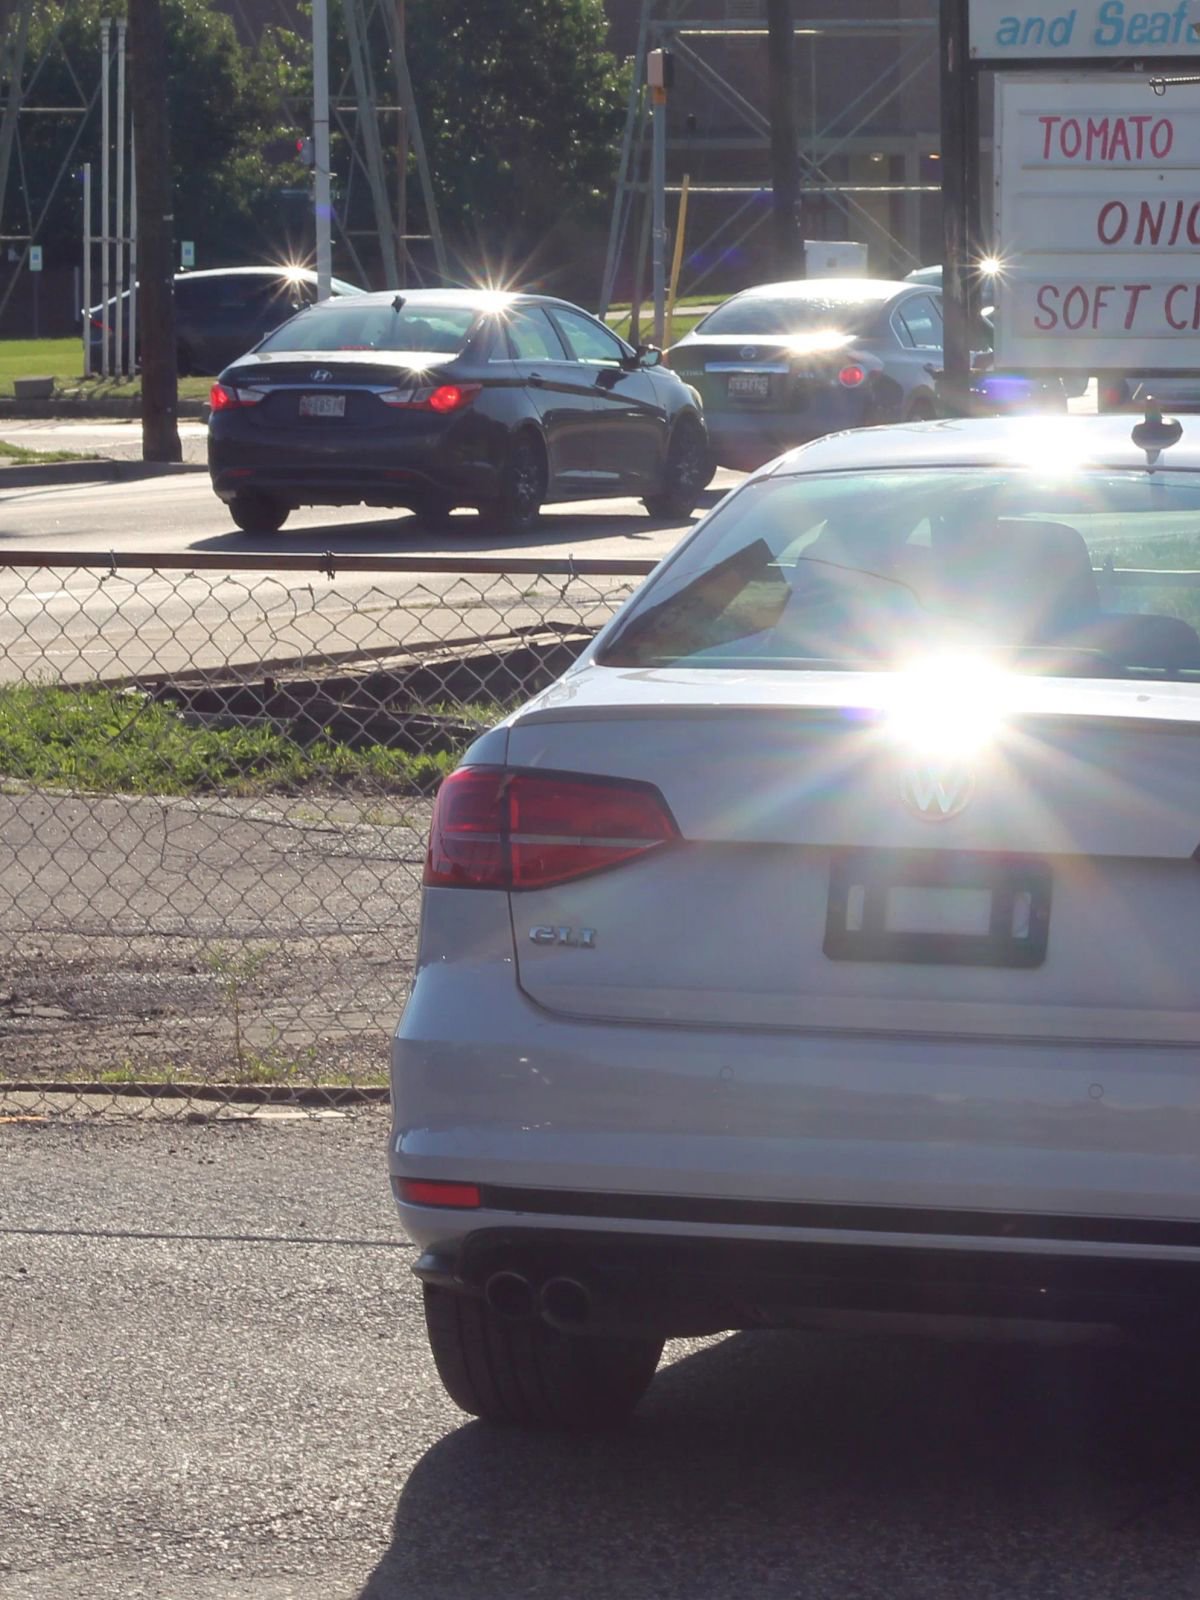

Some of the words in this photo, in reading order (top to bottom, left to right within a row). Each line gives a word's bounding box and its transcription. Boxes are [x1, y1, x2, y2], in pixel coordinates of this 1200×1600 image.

[997, 9, 1076, 47] and
[1038, 115, 1174, 162] TOMATO
[1034, 284, 1151, 331] SOFT
